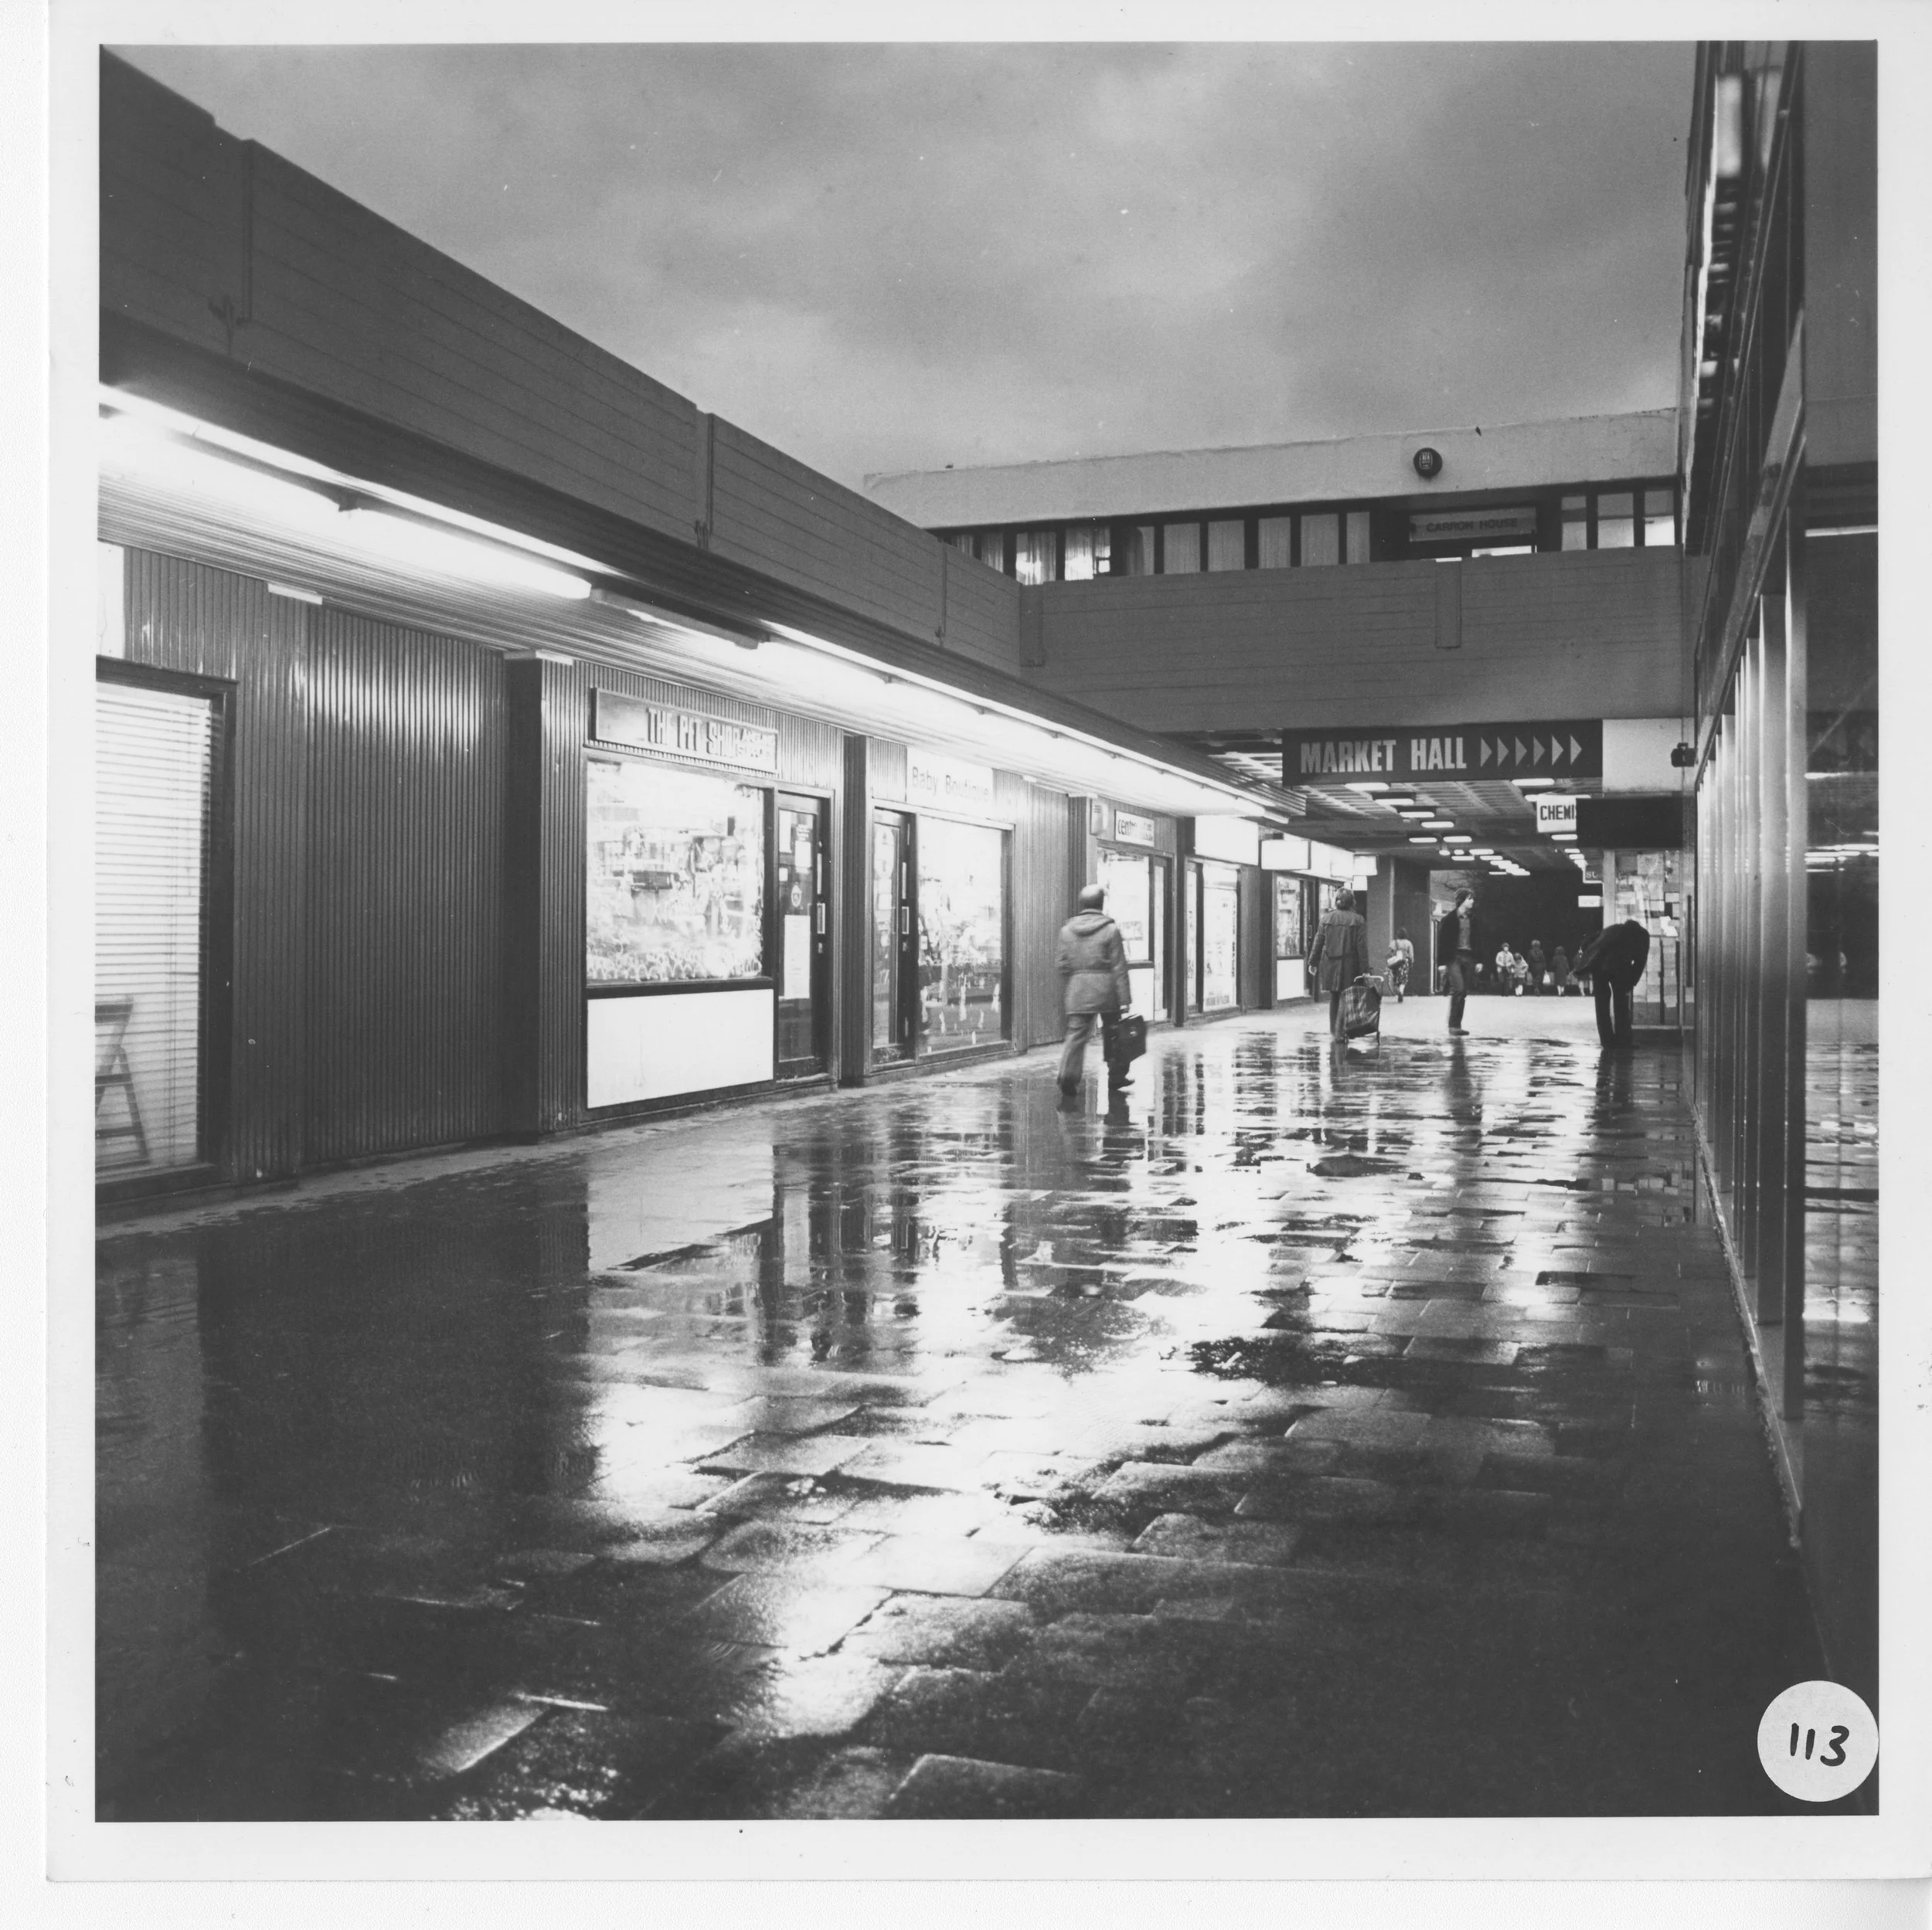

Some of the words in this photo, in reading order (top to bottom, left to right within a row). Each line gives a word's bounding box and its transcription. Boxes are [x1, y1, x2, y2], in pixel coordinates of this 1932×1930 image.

[1427, 521, 1473, 532] CARRON
[1480, 518, 1518, 529] HOUSE
[706, 721, 740, 759] SHOP
[1301, 739, 1396, 773] MARKET
[1410, 736, 1468, 771] HALL
[913, 766, 937, 796] Baby
[946, 775, 989, 802] Boutique
[1790, 1722, 1850, 1767] 113
